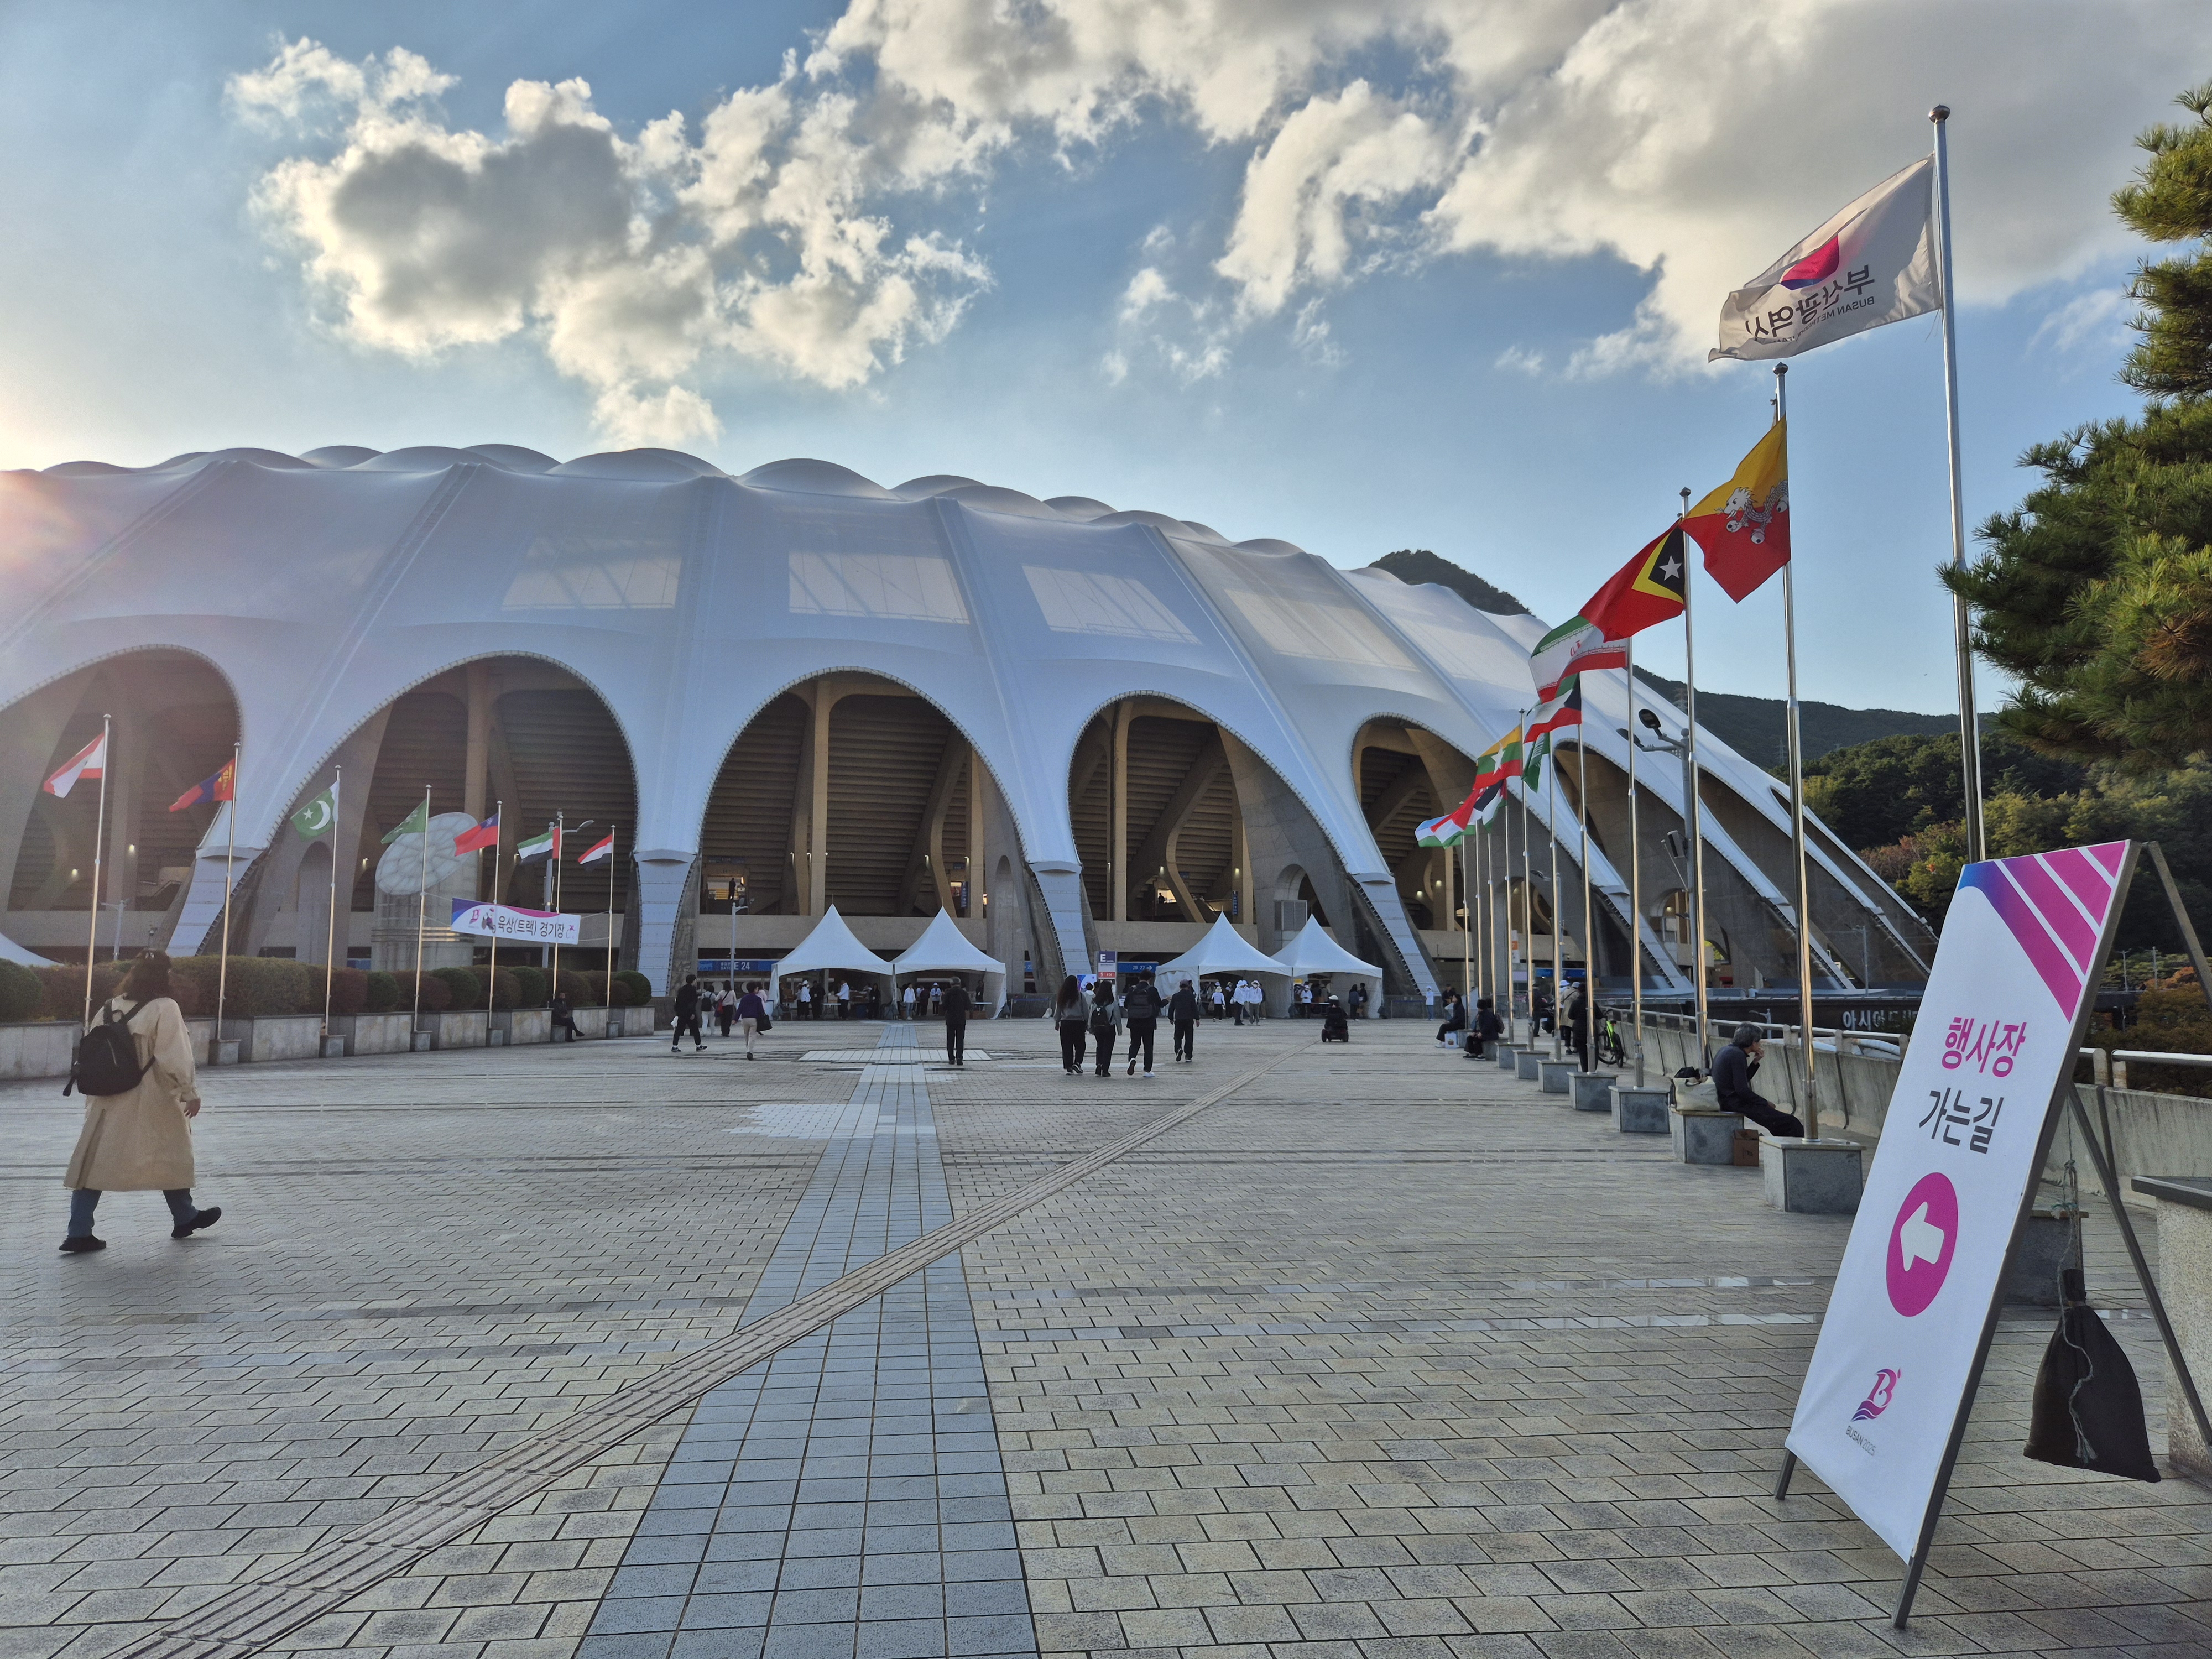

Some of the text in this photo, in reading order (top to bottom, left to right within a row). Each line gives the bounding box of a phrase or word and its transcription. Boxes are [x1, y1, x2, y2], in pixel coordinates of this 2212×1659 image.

[498, 916, 565, 938] 육상(트랙) 경기장
[734, 962, 750, 970] E 24
[1942, 1016, 2027, 1077] 행사장
[1919, 1087, 2004, 1154] 가는길
[1846, 1425, 1876, 1457] BUSAN 2025
